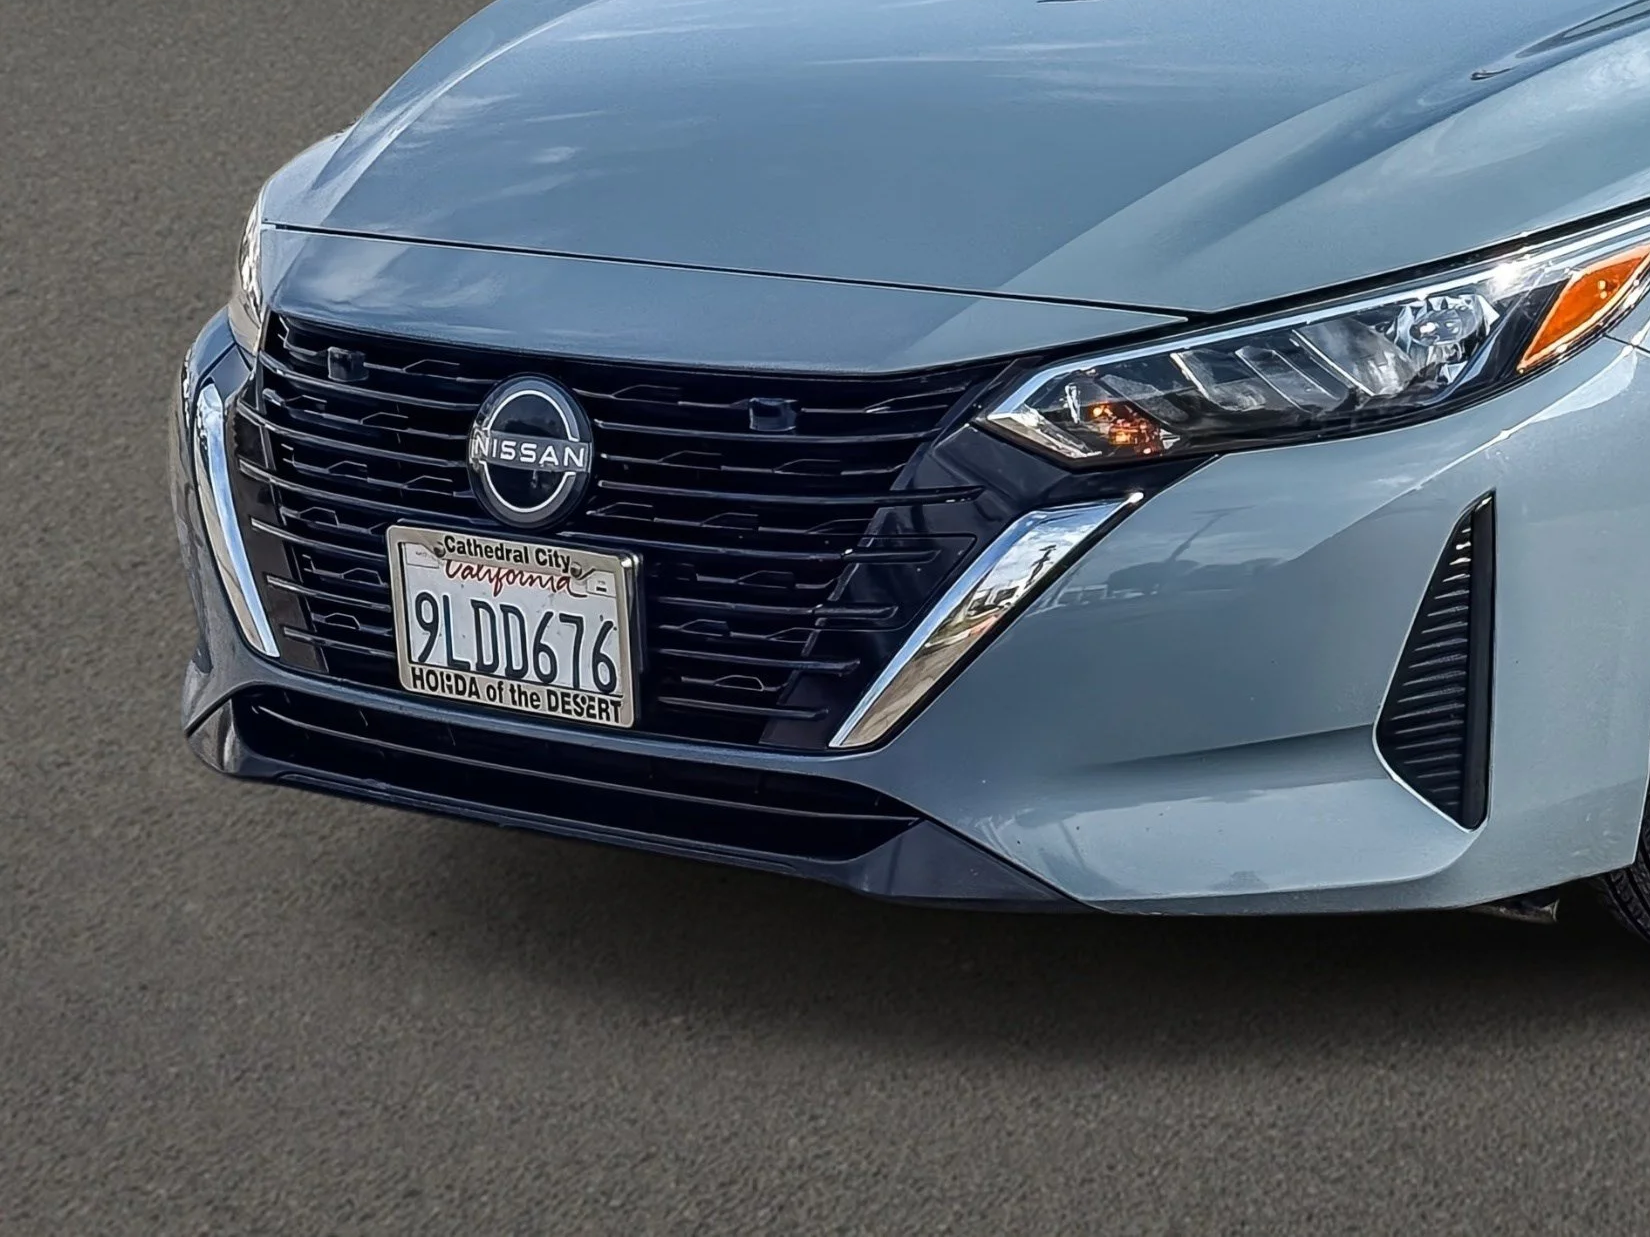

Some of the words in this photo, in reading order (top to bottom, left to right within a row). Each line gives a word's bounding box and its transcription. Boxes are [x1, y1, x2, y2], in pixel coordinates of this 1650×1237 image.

[473, 434, 585, 468] NISSAN
[443, 535, 530, 564] Cathedral
[534, 546, 571, 574] City
[445, 560, 588, 597] California
[414, 591, 618, 695] 9LDD676
[411, 666, 481, 700] HONDA
[486, 680, 504, 704] of
[509, 683, 541, 709] the
[546, 689, 624, 723] DESERT
